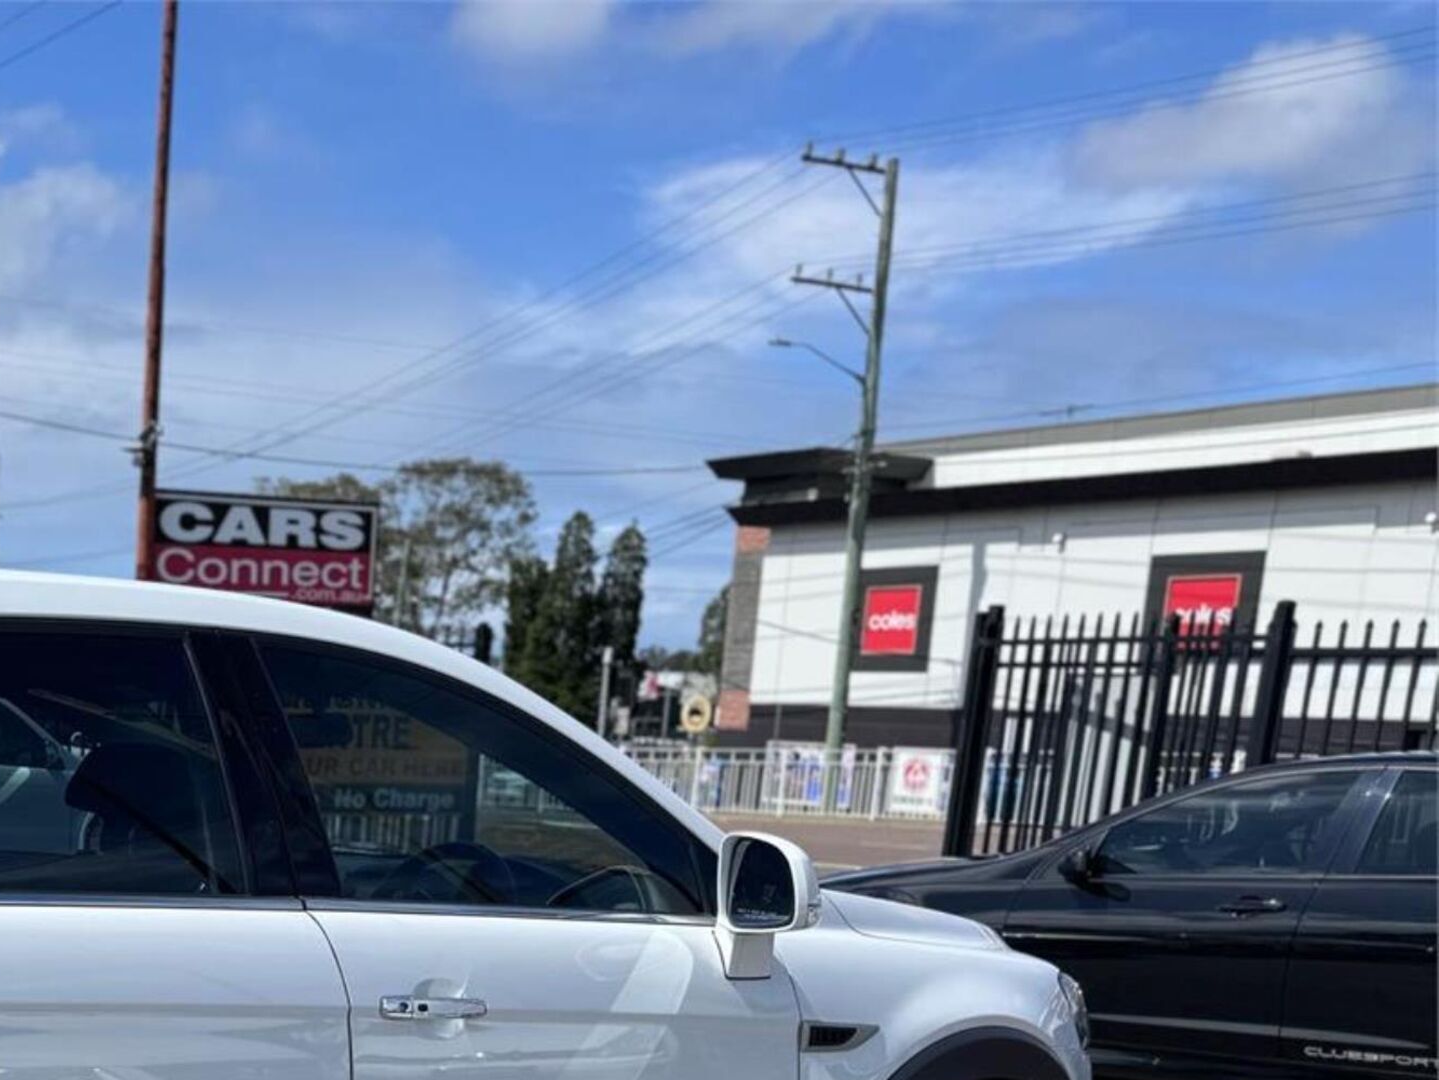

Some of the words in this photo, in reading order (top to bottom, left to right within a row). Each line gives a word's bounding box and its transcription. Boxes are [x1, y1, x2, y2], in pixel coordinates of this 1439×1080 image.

[159, 500, 365, 550] CARS
[156, 547, 364, 589] Connect
[868, 609, 917, 632] coles
[334, 787, 366, 810] No
[373, 787, 455, 813] Charge
